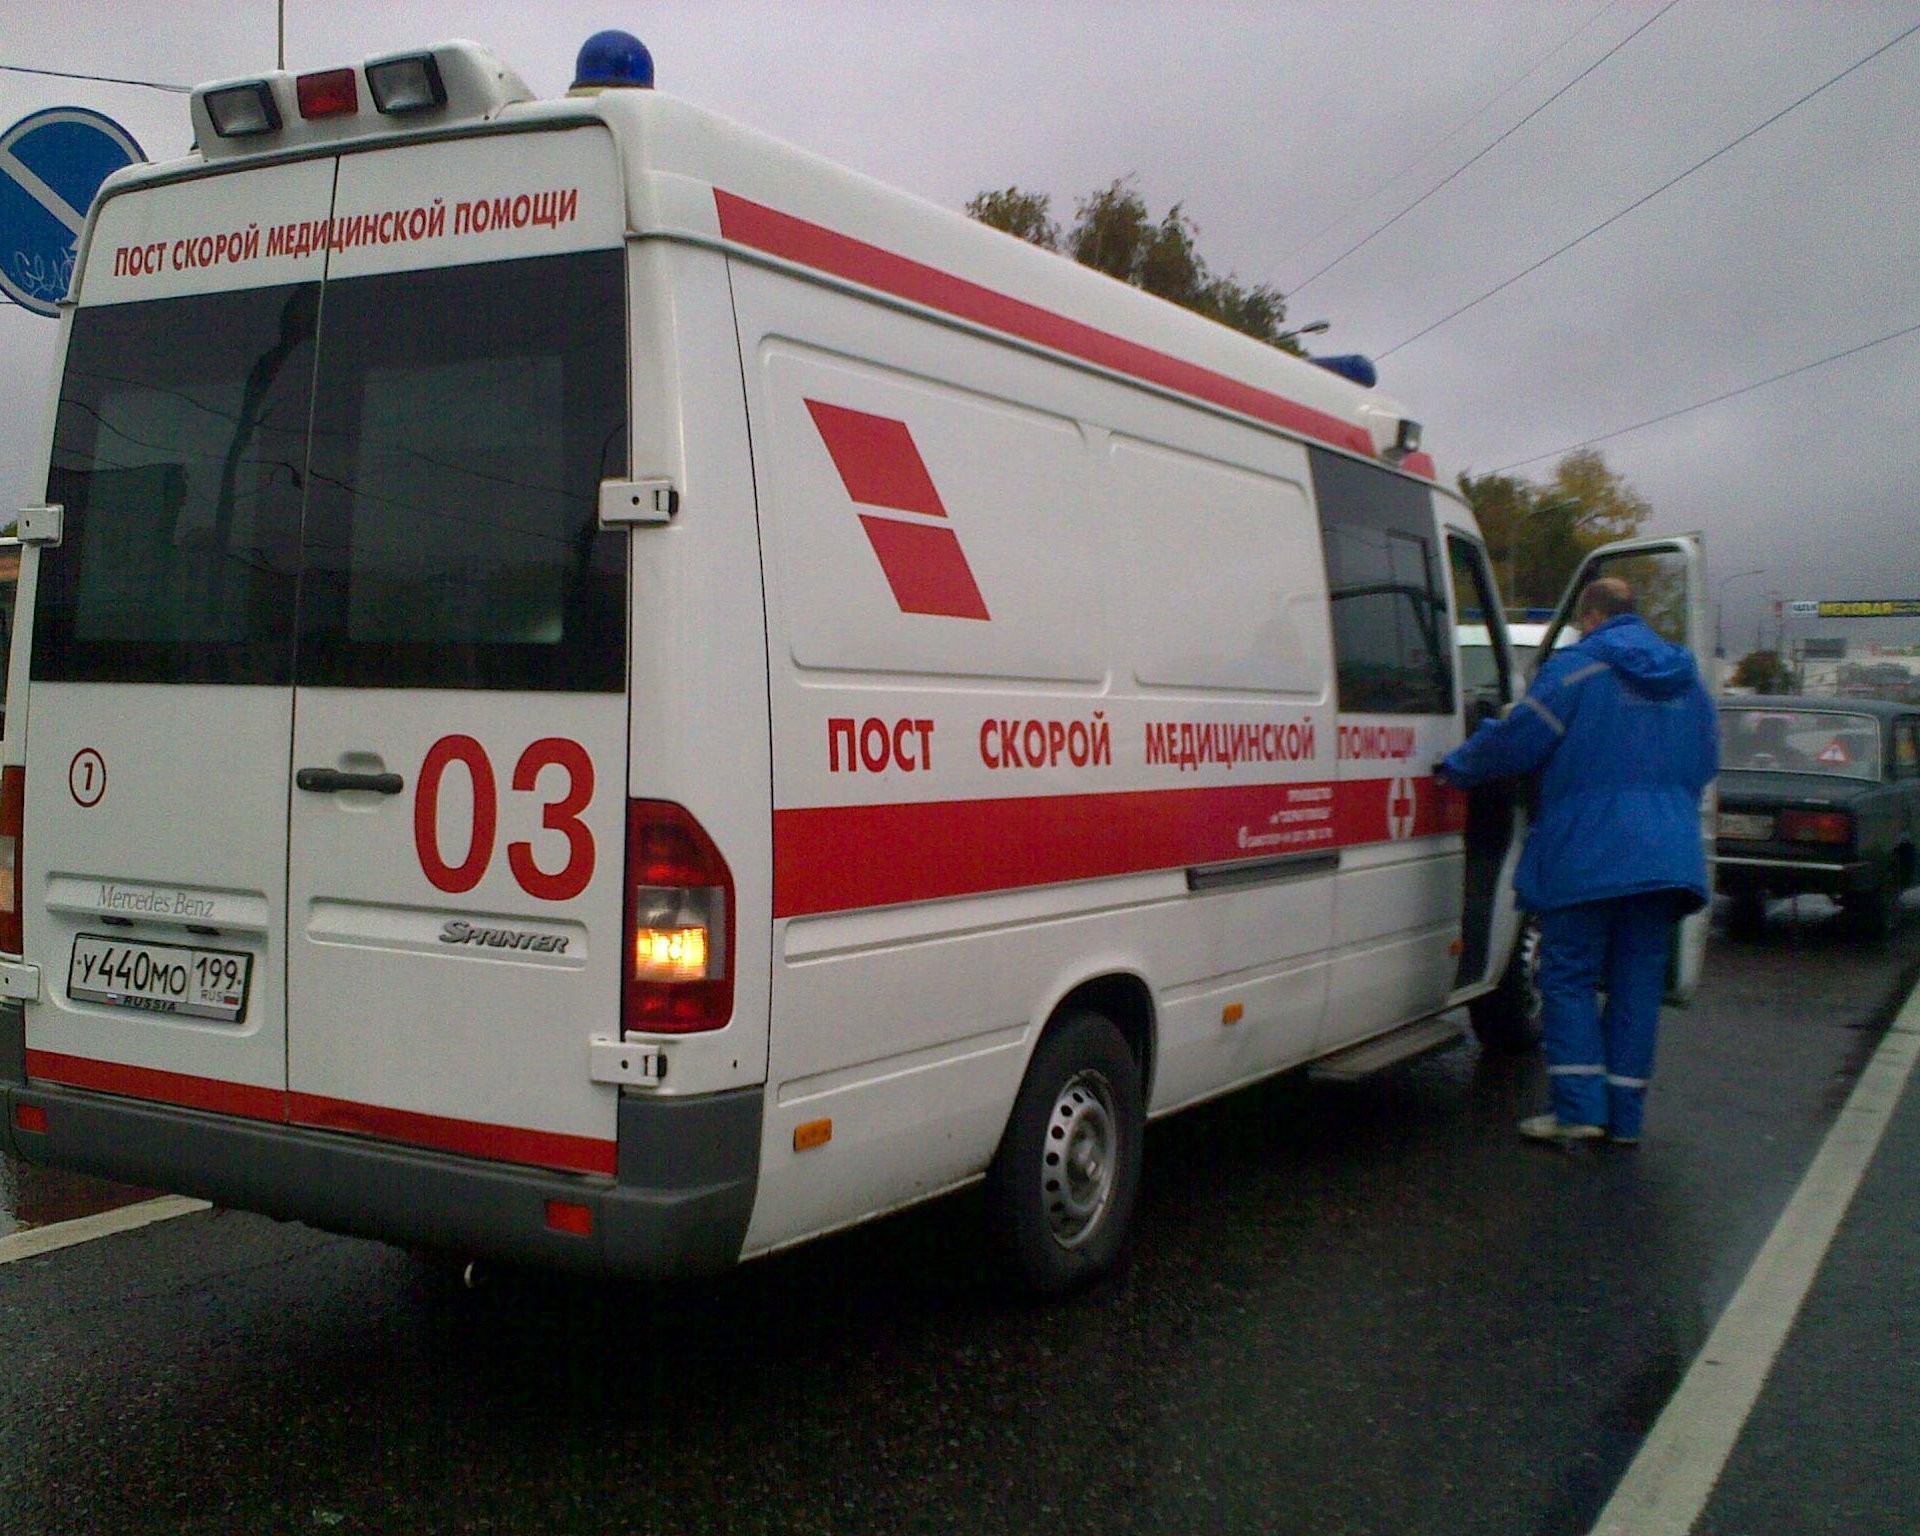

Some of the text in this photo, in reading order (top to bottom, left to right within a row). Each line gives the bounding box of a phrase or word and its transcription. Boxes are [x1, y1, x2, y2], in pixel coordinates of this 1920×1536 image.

[114, 242, 167, 277] ПОСТ
[172, 223, 260, 271] СКОРОЙ
[266, 199, 446, 259] МЕДИЦИНСКОЙ
[454, 188, 578, 236] ПОМОЩИ
[828, 711, 1417, 773] ПОСТ СКОРОЙ МЕДИЦИНСКОЙ ПОМОЩИ
[414, 734, 596, 901] 03
[123, 995, 176, 1012] RUSSIA
